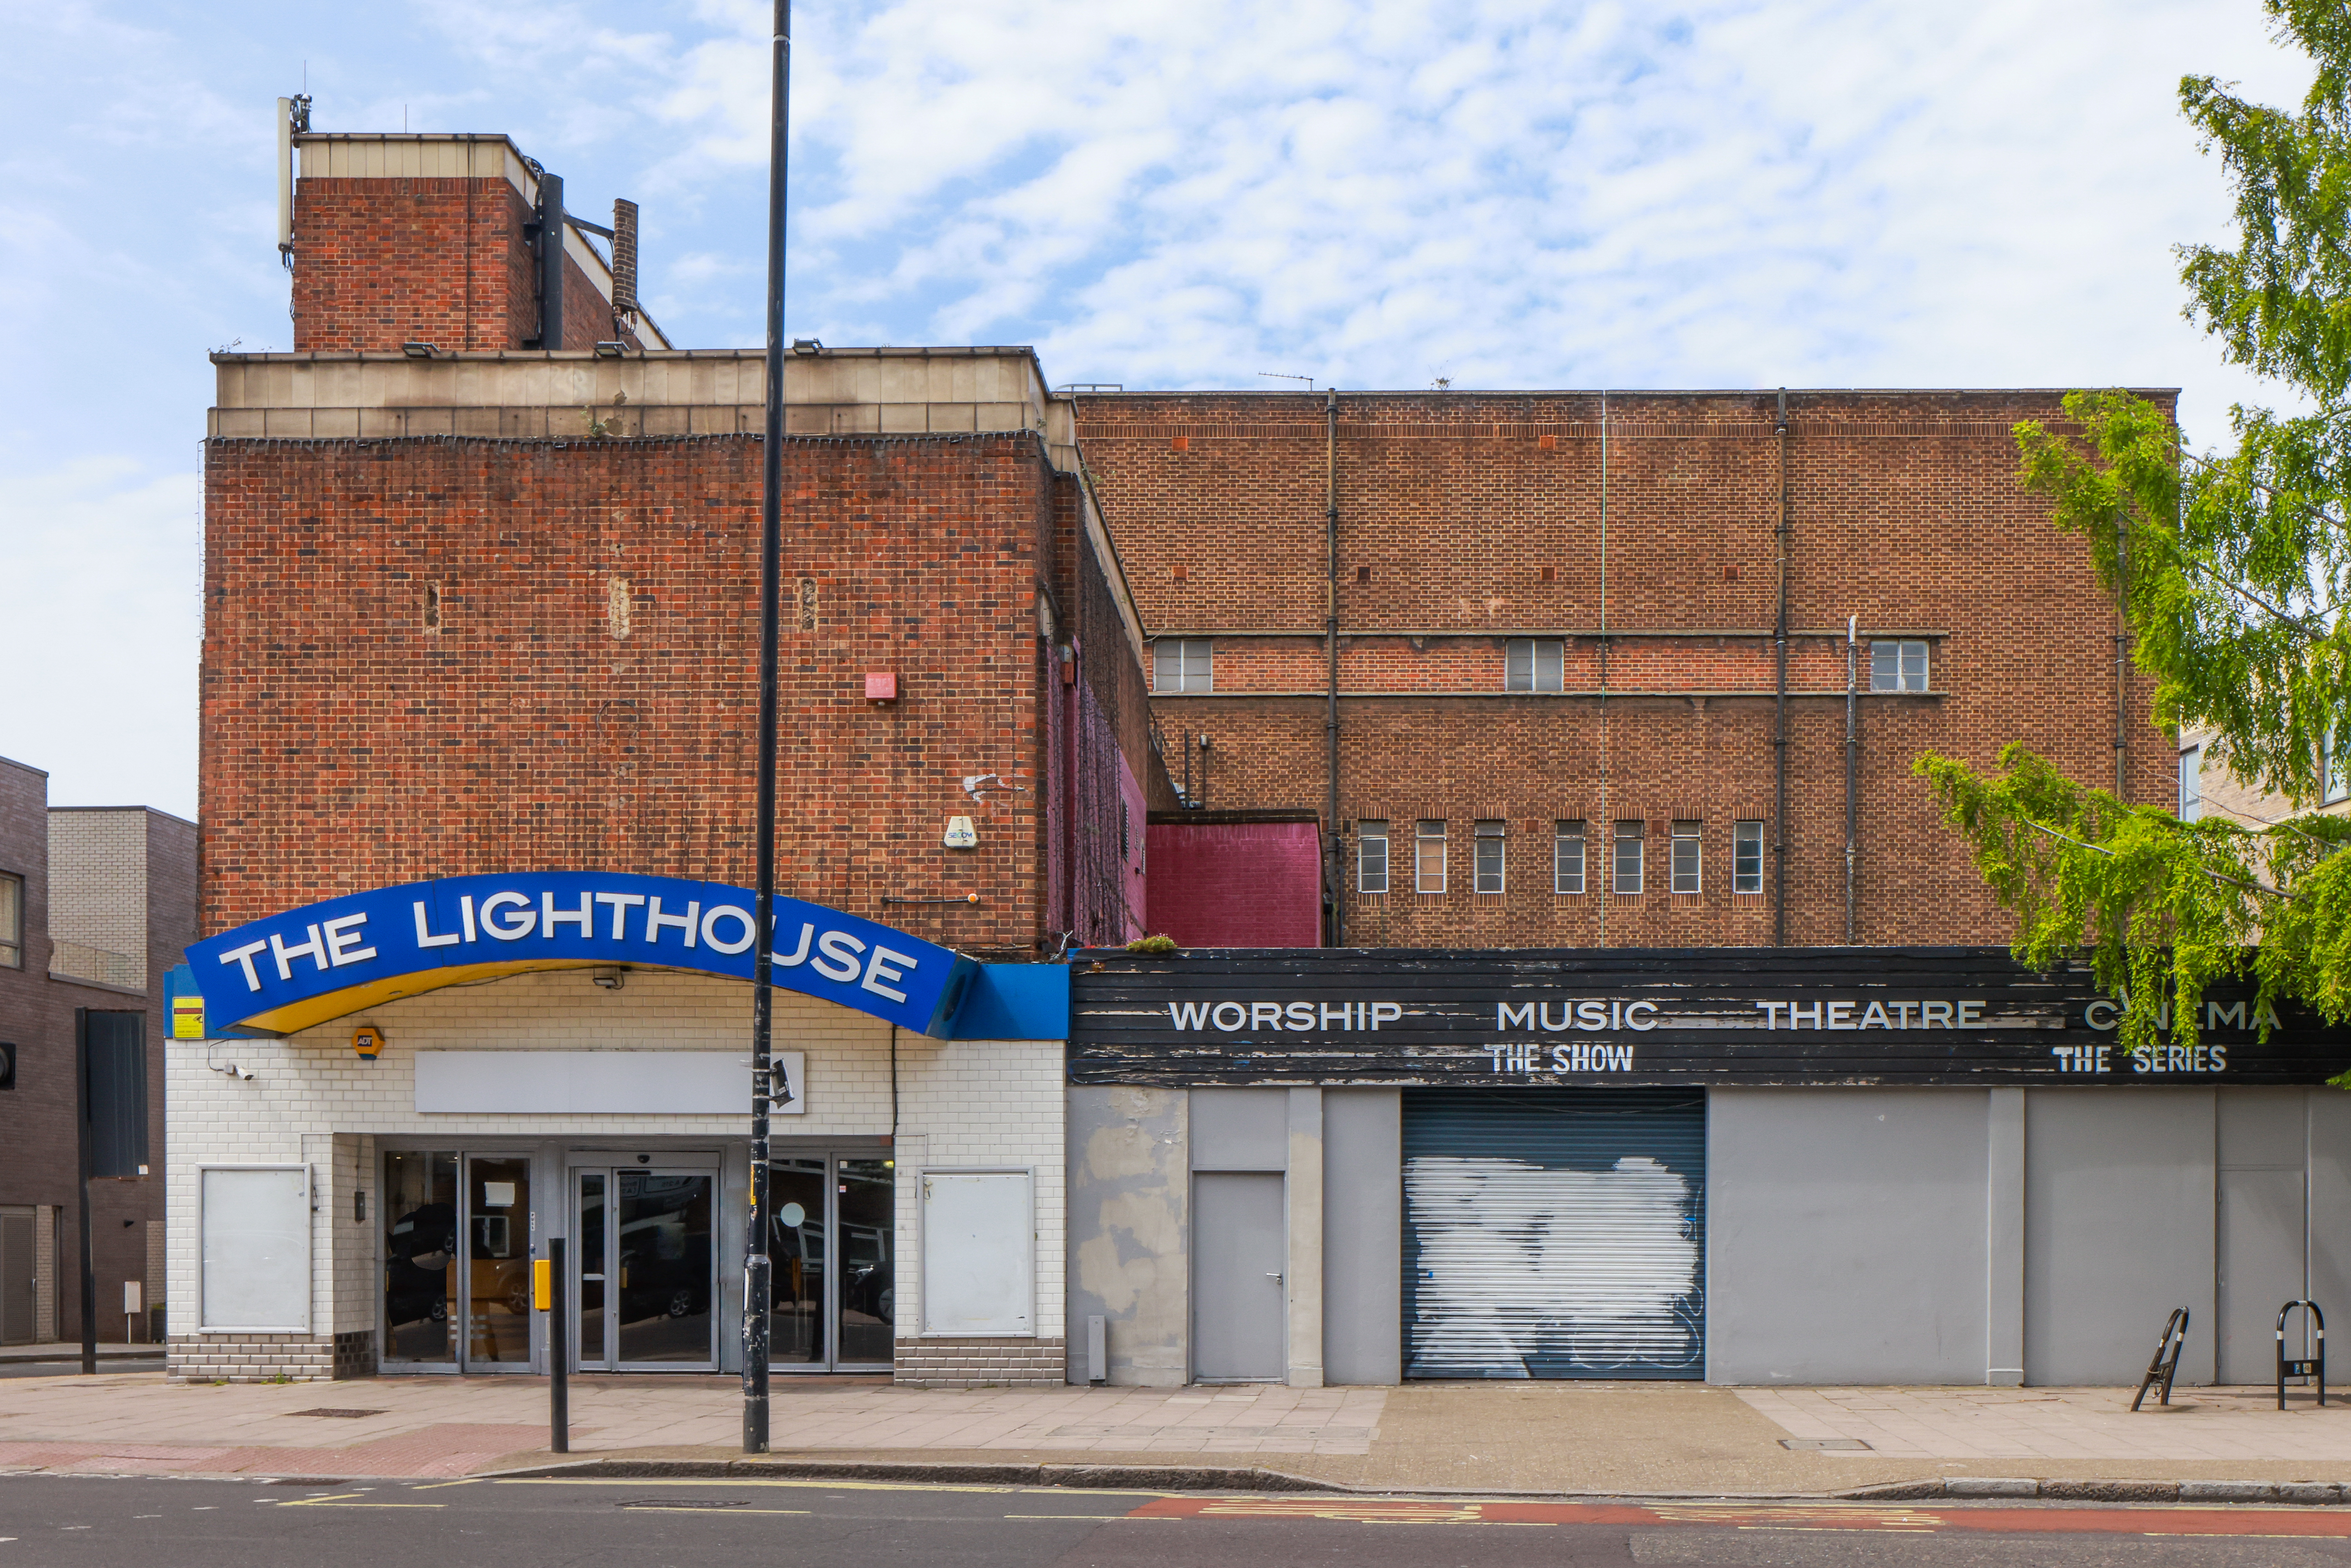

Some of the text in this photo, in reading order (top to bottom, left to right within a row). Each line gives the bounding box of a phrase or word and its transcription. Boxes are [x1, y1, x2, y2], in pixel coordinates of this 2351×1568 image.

[219, 891, 918, 1003] THE LIGHTHOUSE
[1168, 1001, 1402, 1031] WORSHIP
[1496, 1001, 1658, 1031] MUSIC
[1756, 1001, 1987, 1031] THEATRE
[358, 1037, 373, 1045] ADT
[1484, 1044, 1634, 1075] THE SHOW
[2052, 1045, 2227, 1073] THE SERIES
